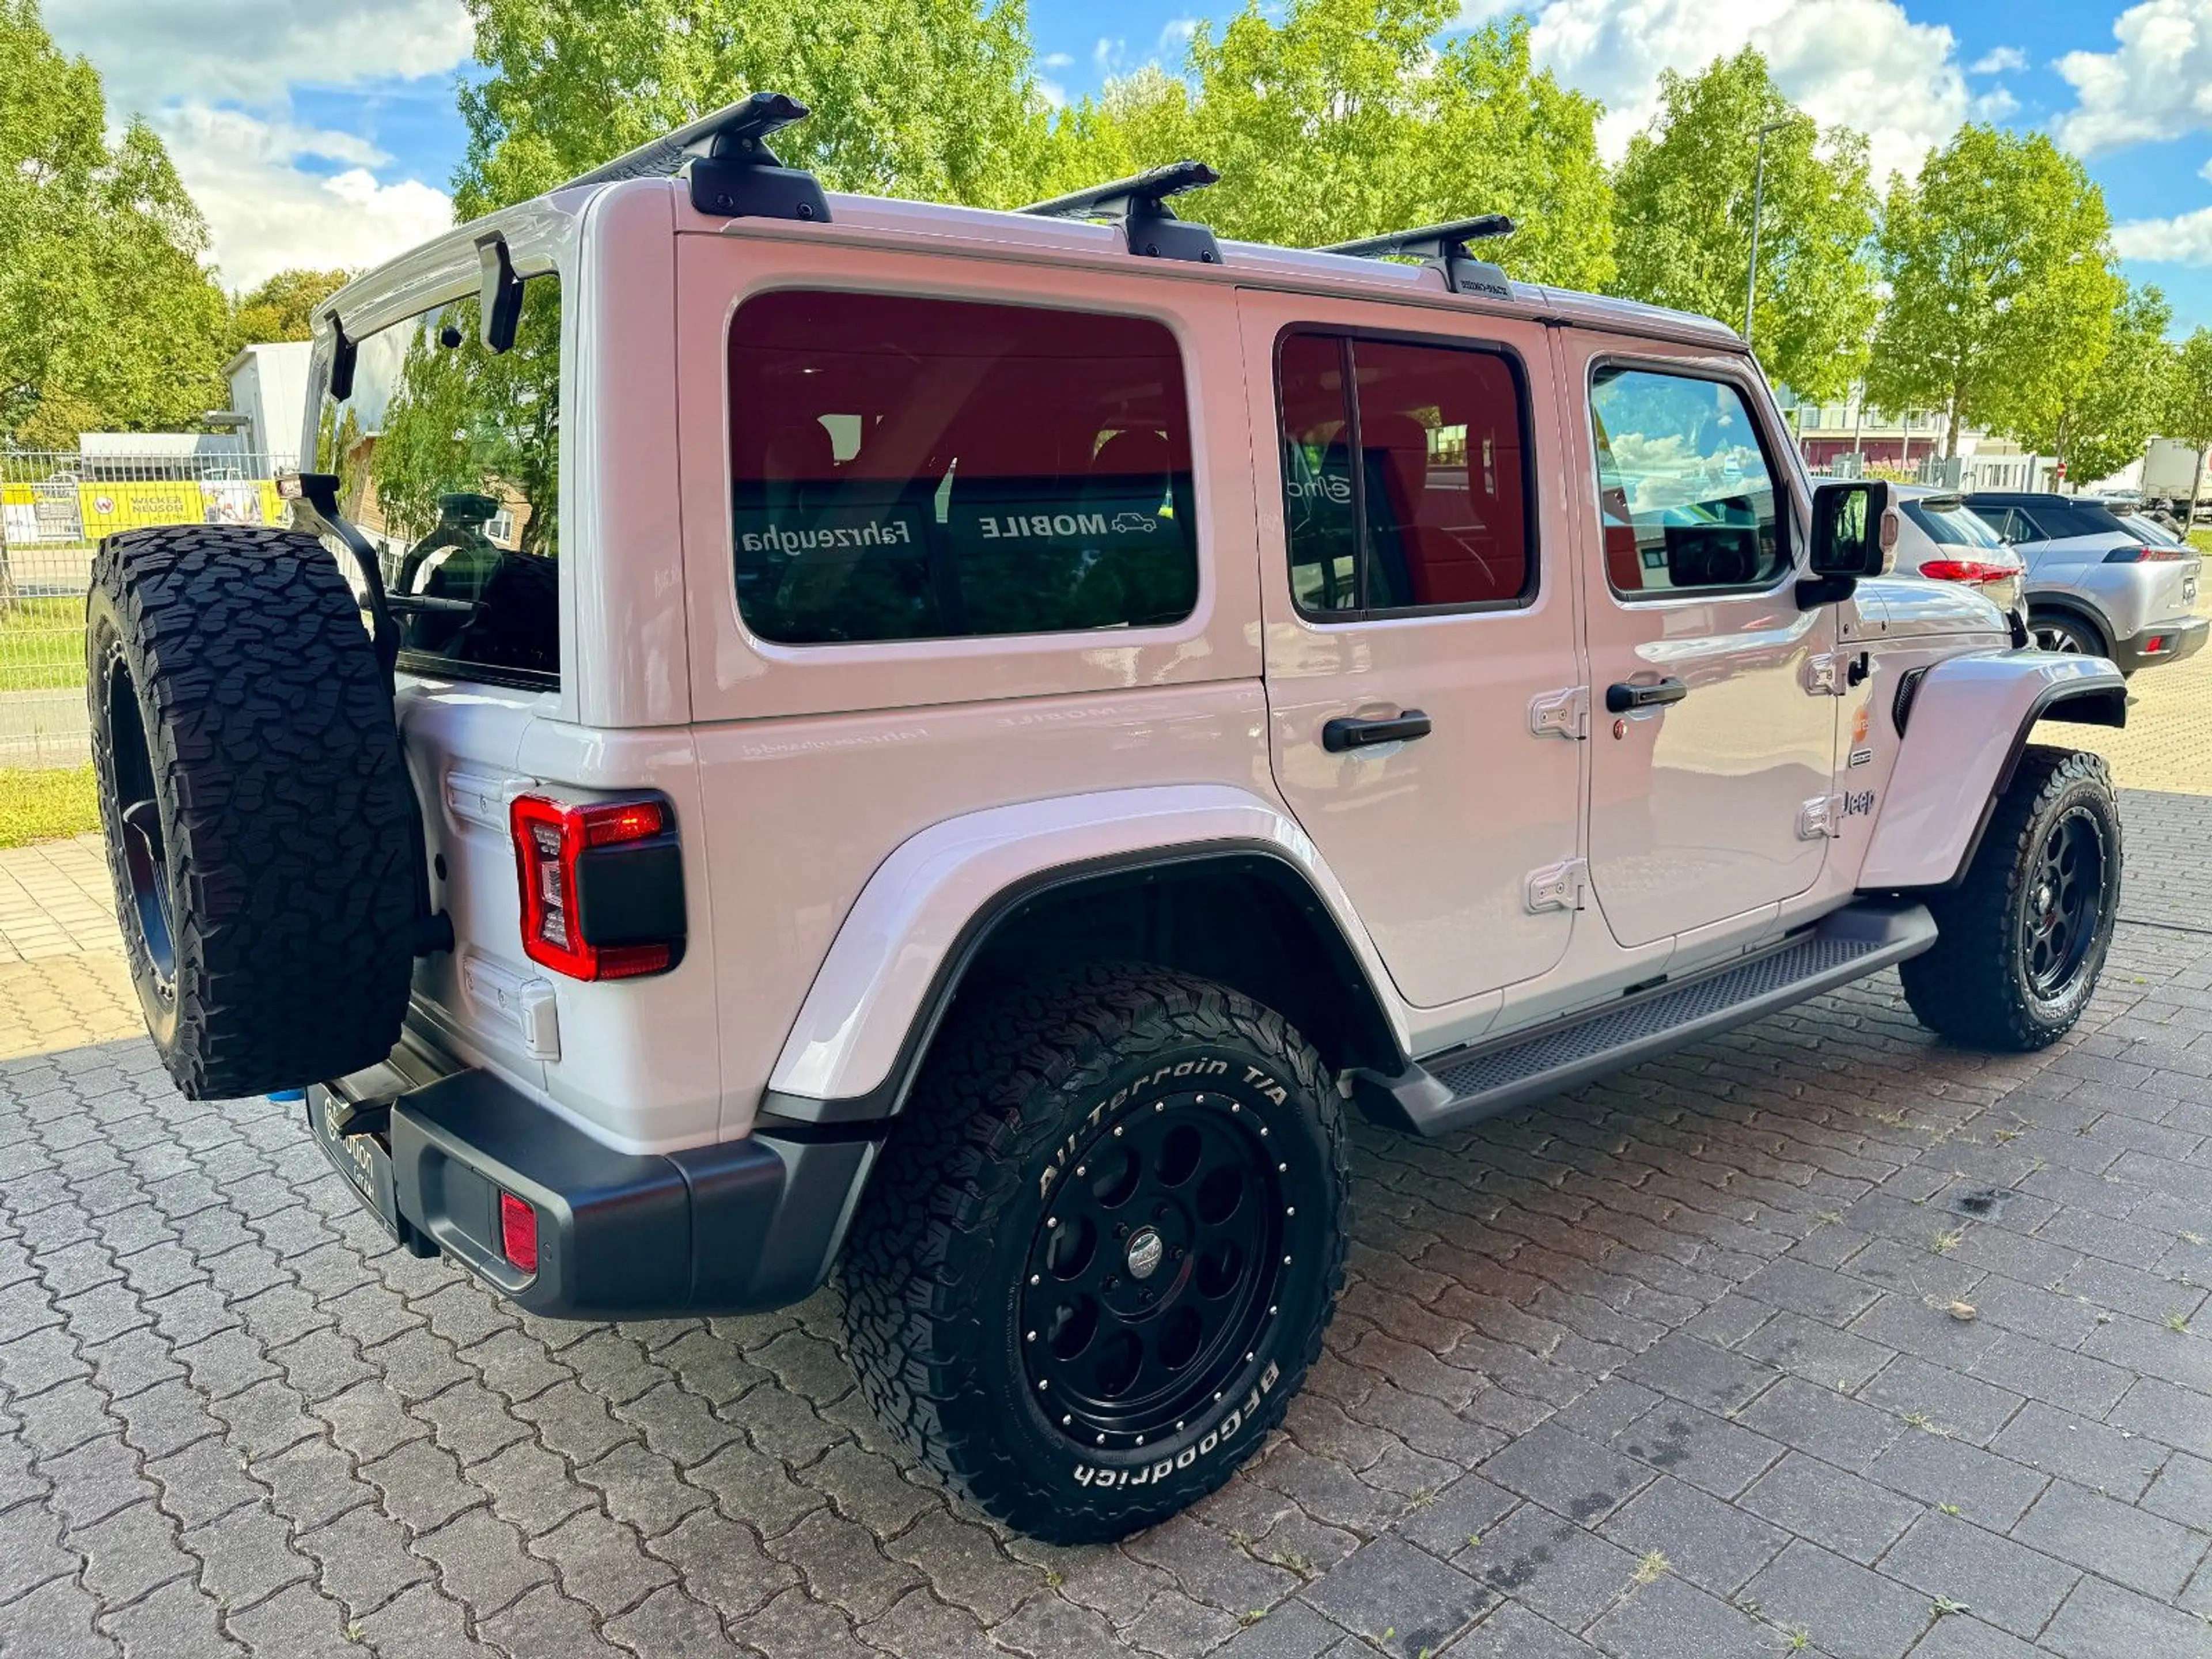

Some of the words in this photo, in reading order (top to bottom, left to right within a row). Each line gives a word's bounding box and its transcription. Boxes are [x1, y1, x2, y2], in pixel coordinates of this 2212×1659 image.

[1843, 790, 1874, 815] Jeep
[1039, 1056, 1228, 1199] All-Terrain
[1240, 1065, 1290, 1108] T/A
[1073, 1359, 1282, 1491] BFGoodrich
